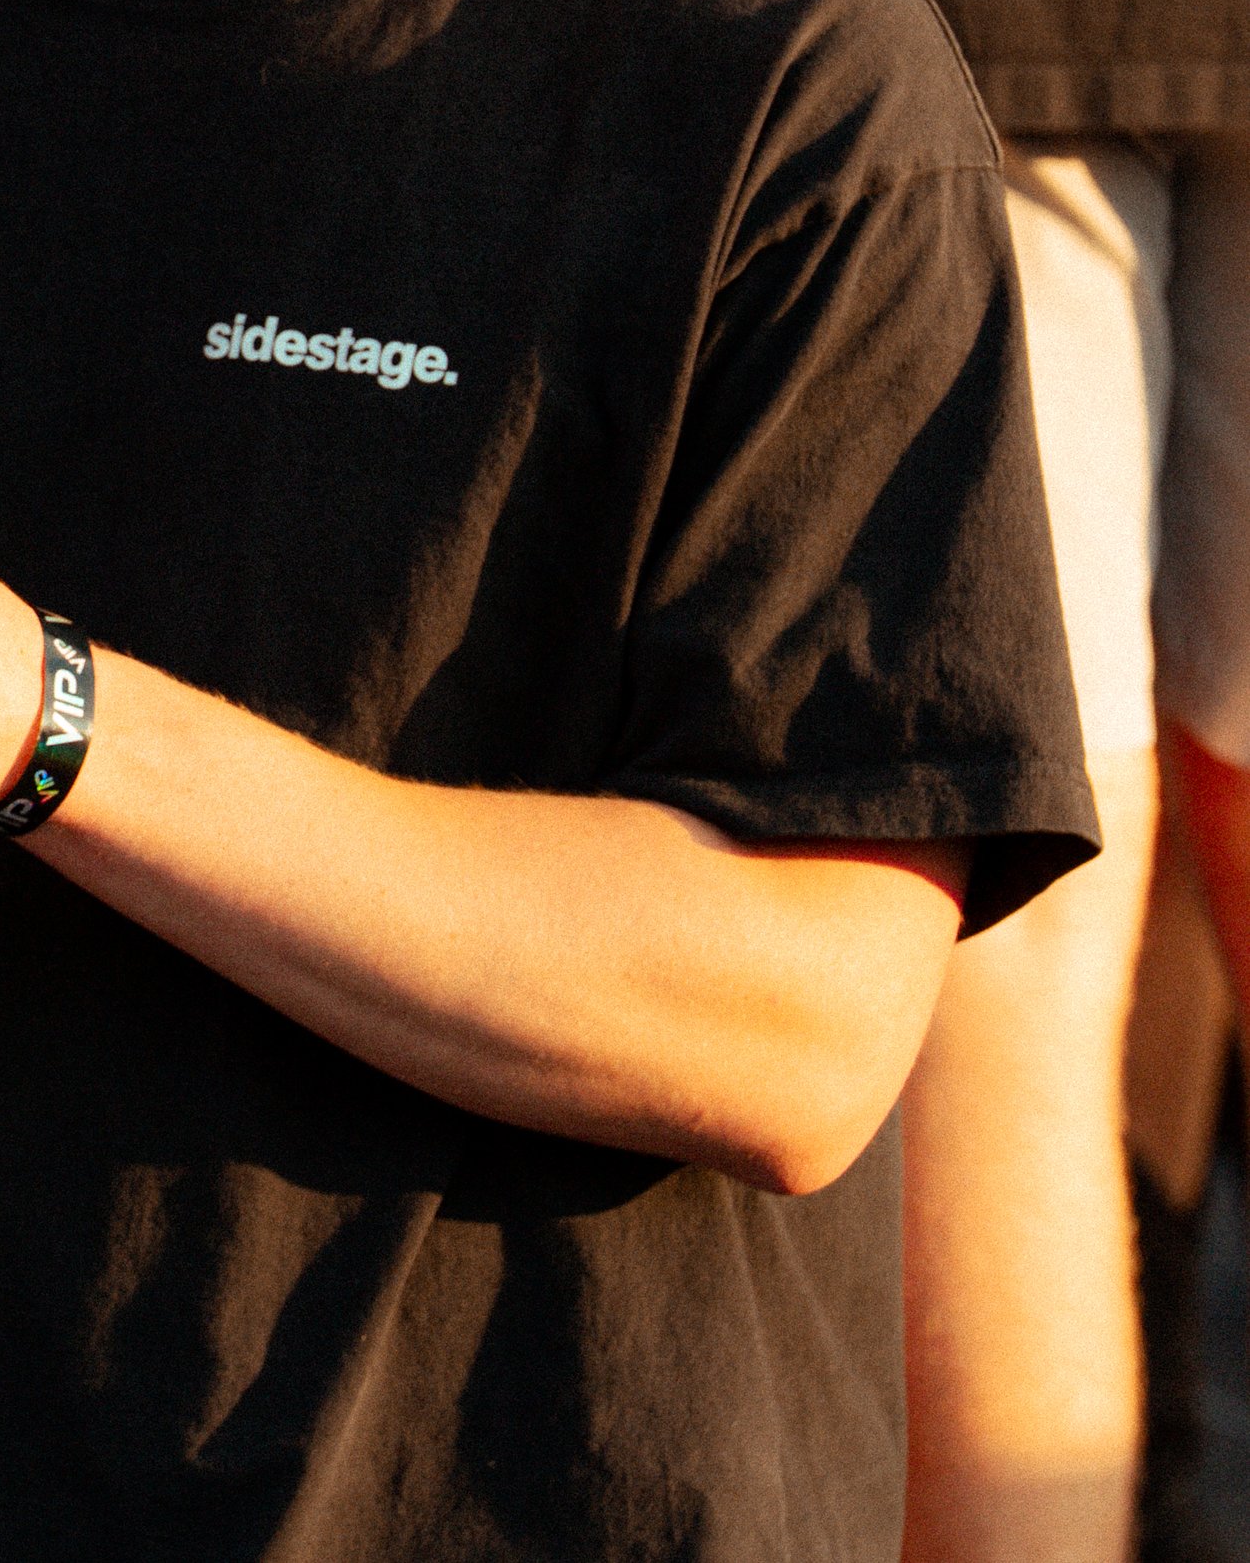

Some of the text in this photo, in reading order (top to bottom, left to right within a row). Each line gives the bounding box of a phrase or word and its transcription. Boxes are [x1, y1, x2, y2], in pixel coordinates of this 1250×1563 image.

[203, 312, 459, 389] sidestage.
[53, 638, 86, 674] VIP
[46, 669, 85, 746] VIP
[34, 769, 59, 804] VIP
